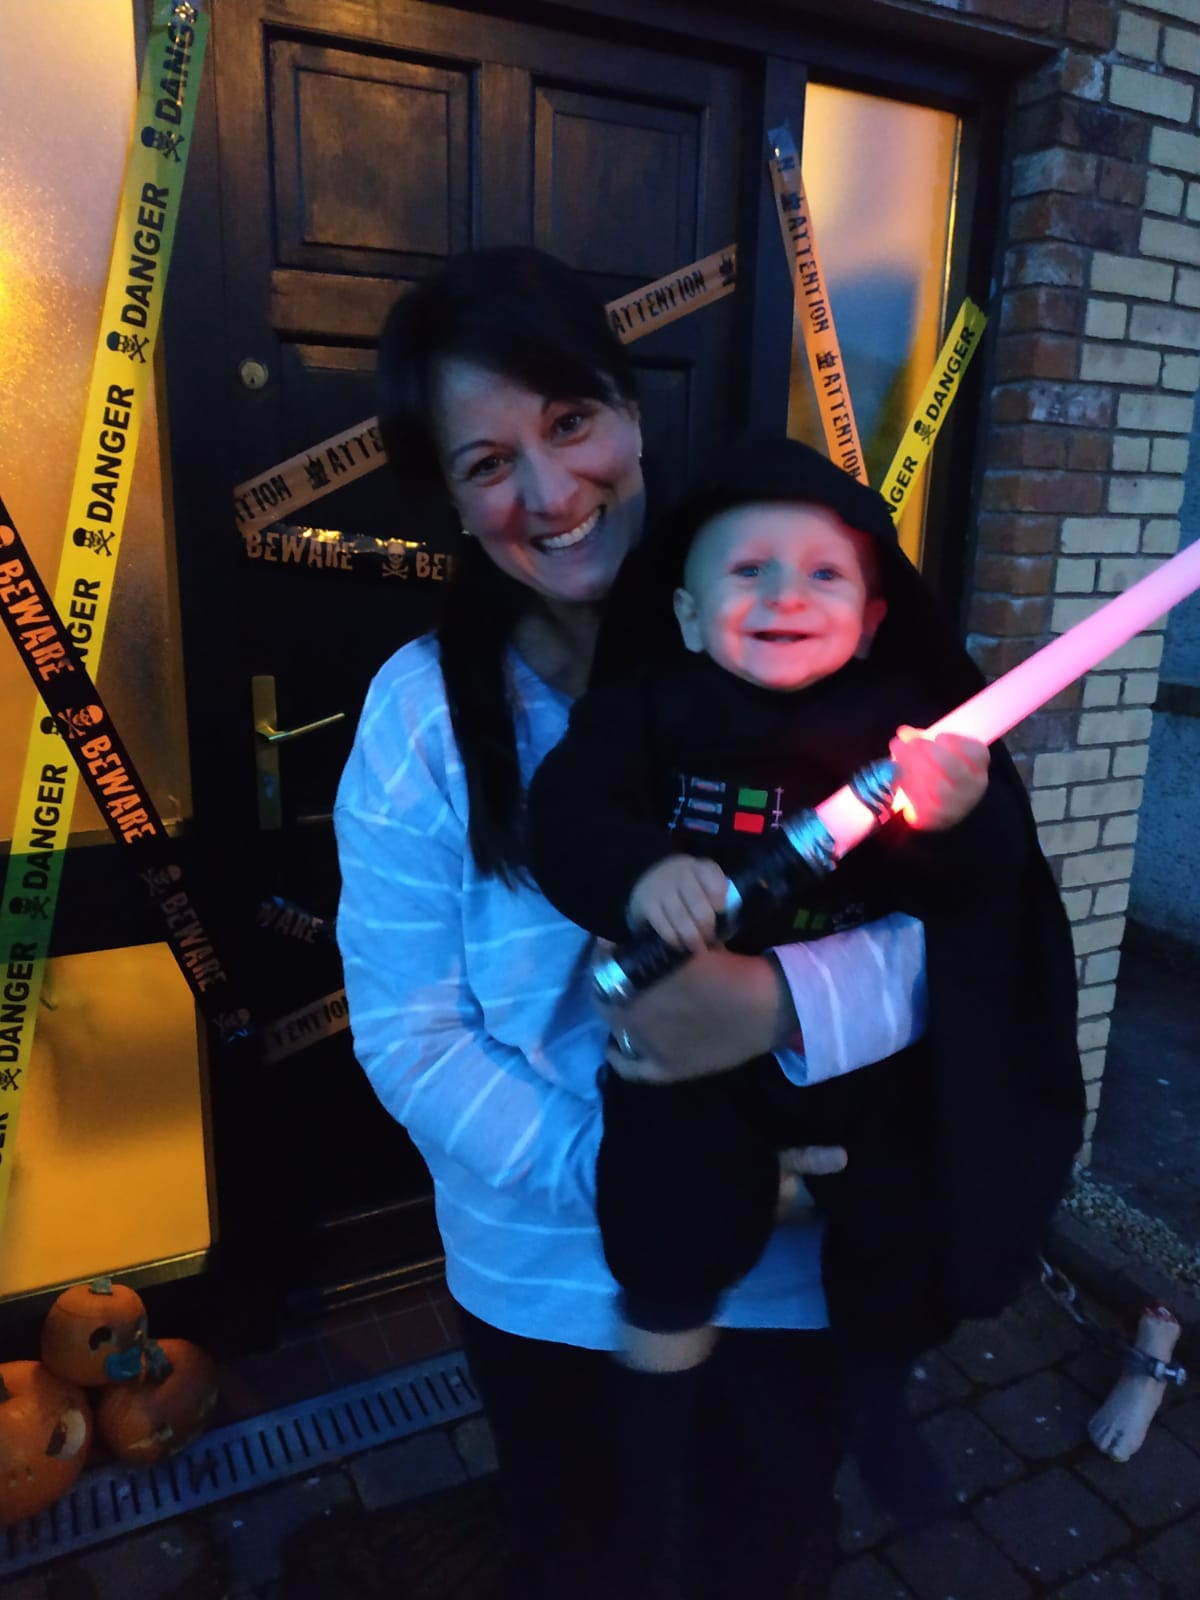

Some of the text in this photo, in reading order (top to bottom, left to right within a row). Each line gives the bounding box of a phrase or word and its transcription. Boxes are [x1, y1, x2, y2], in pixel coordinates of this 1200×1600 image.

[608, 270, 707, 335] ATTENTION
[788, 216, 830, 334] ATTENTION
[926, 325, 976, 421] DANGER
[245, 531, 353, 571] BEWARE
[2, 940, 39, 1063] DANGER
[24, 762, 69, 891] DANGER
[86, 384, 135, 523] DANGER
[121, 182, 170, 329] DANGER
[0, 558, 228, 993] BEWARE BEWARE BEWARE
